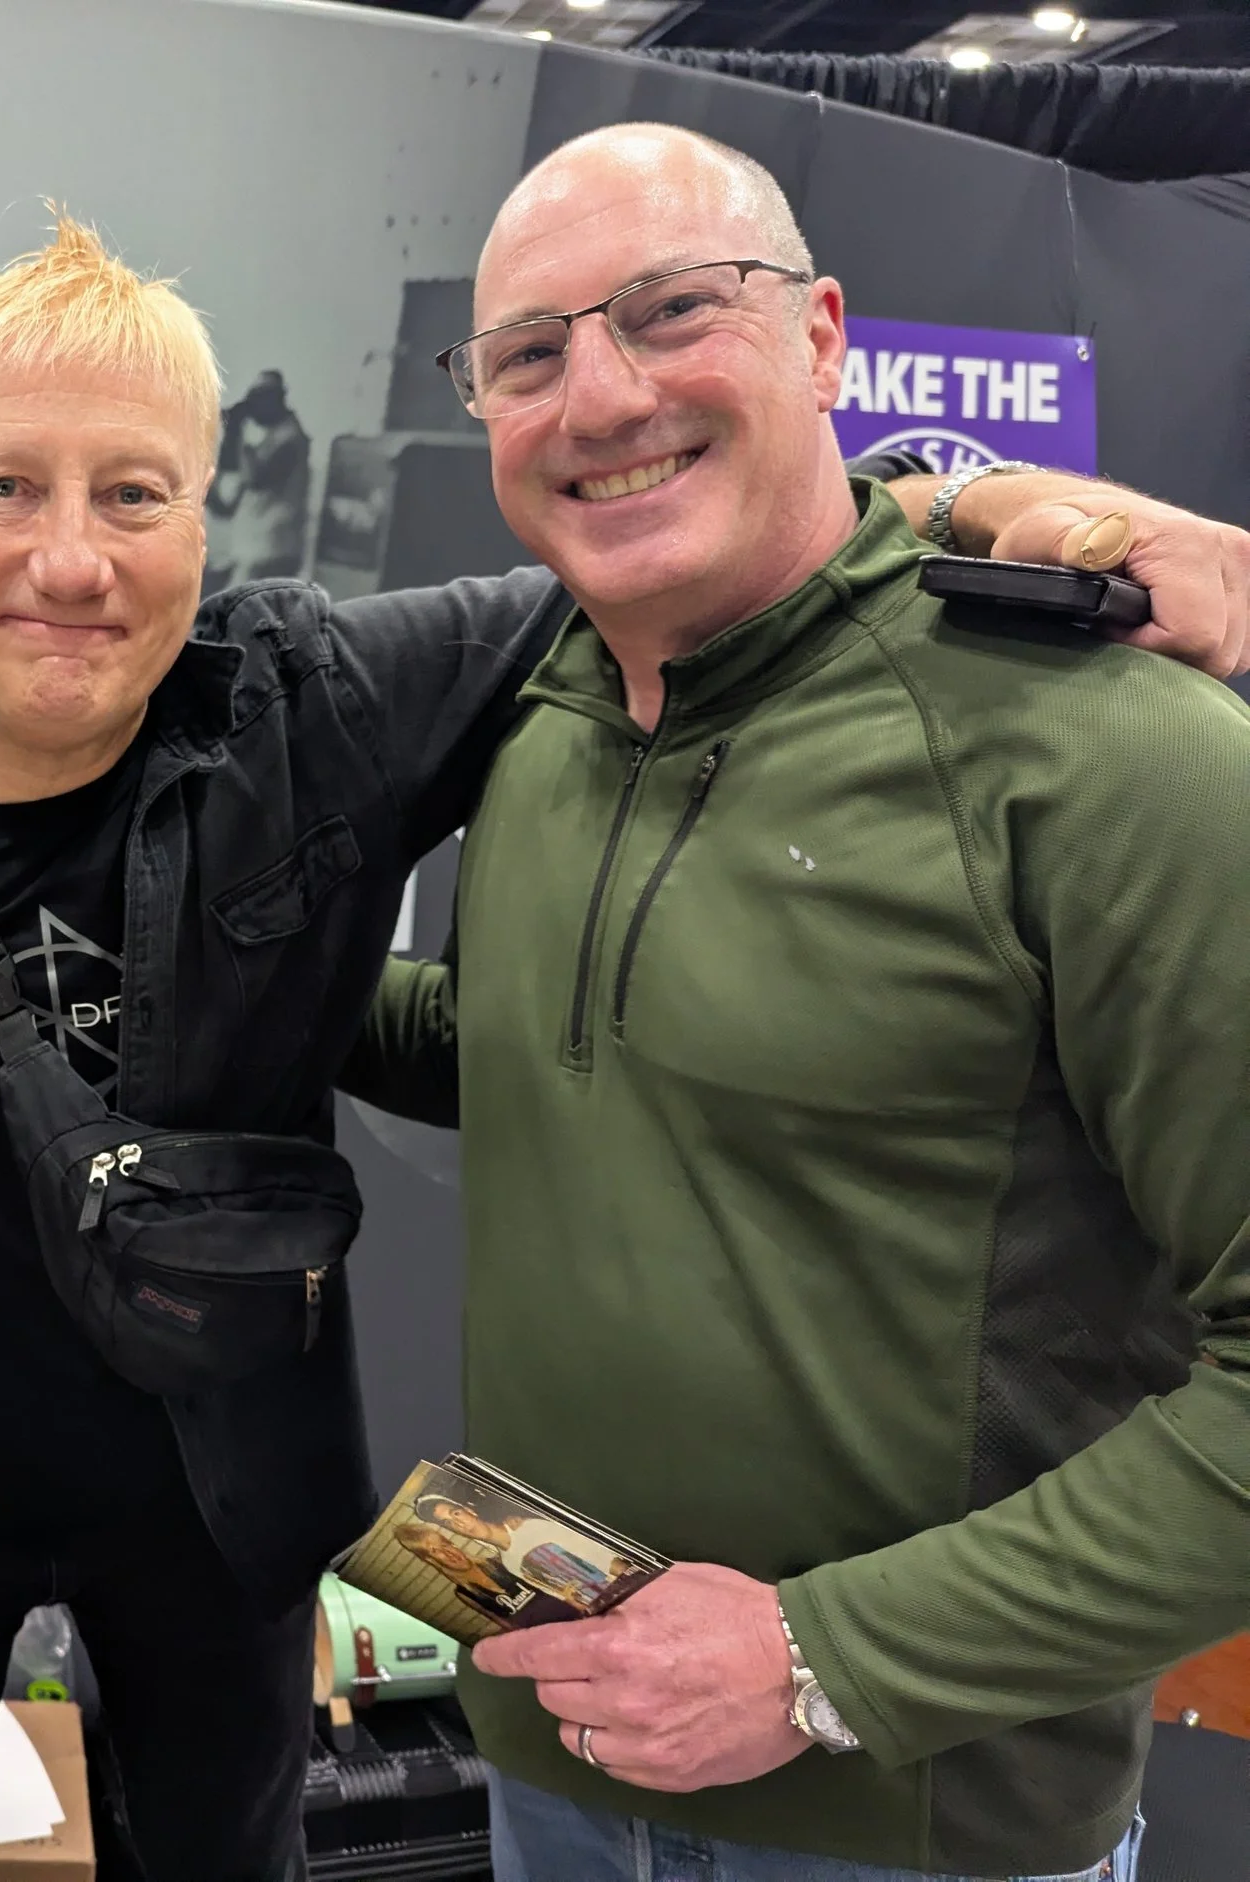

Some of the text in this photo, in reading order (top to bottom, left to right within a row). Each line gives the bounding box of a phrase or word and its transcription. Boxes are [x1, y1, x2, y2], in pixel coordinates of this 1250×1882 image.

[833, 347, 1060, 423] AKE THE
[495, 1582, 536, 1615] Pearl
